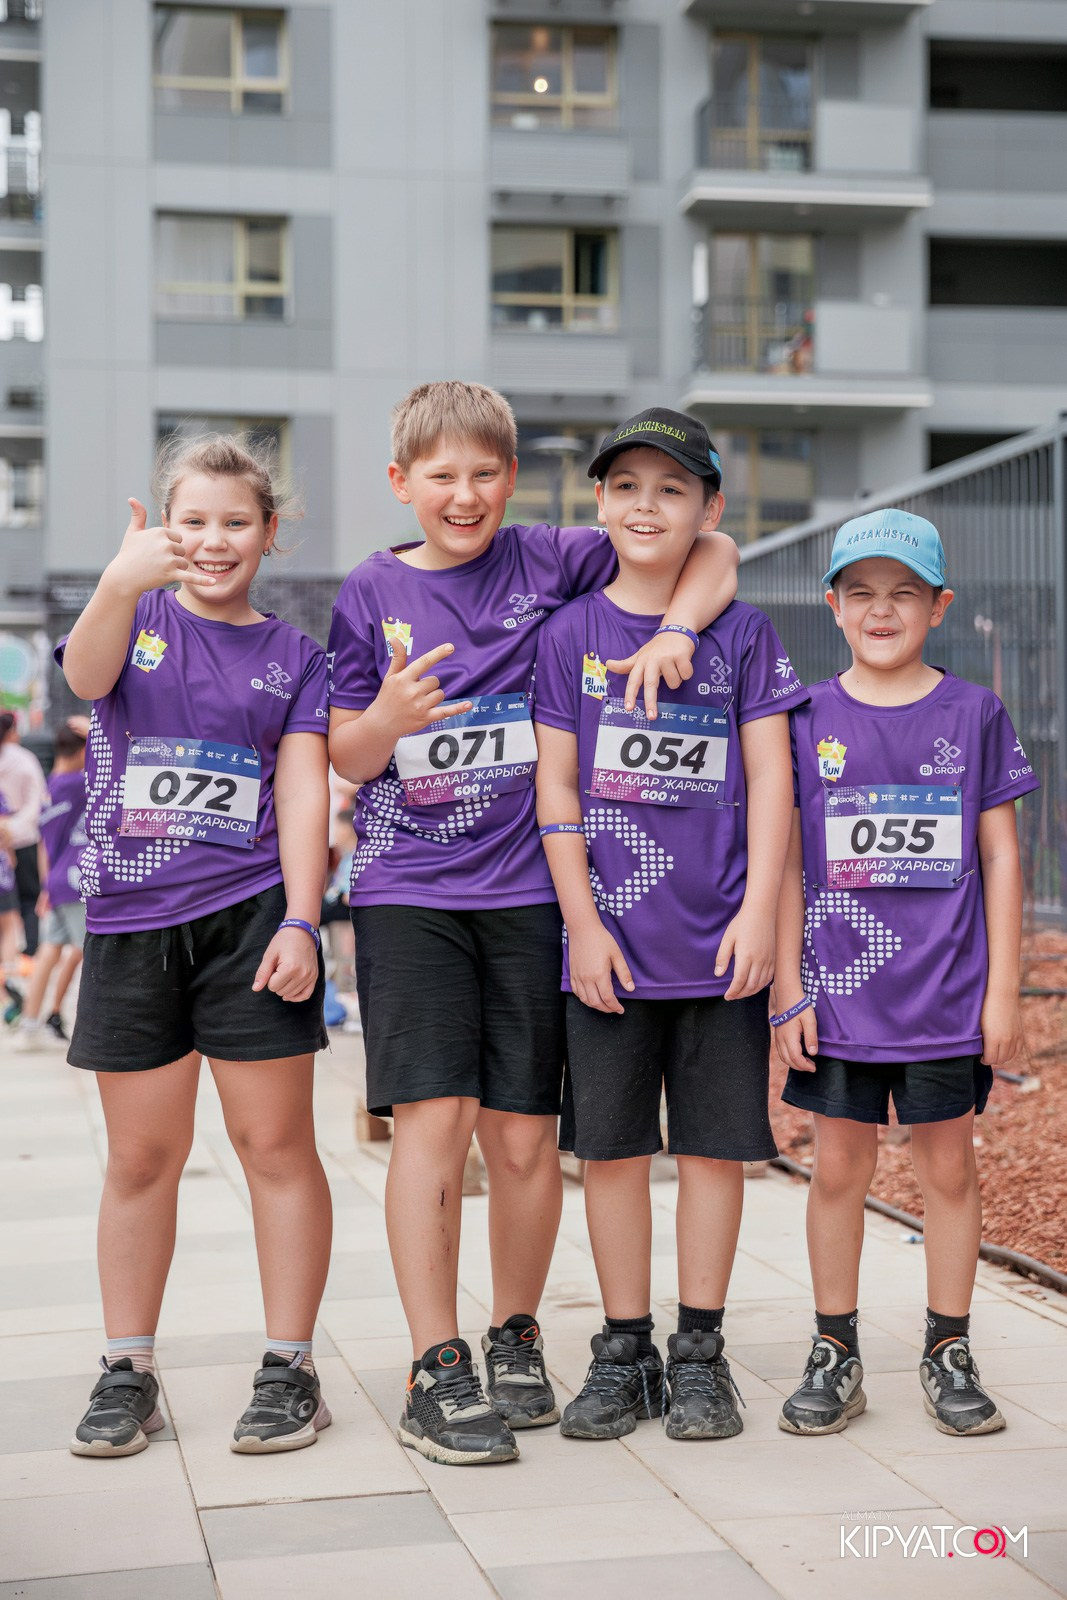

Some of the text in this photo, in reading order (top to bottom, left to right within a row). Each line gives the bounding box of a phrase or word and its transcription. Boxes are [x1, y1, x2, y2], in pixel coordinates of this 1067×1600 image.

[613, 420, 687, 442] KAZAKHSTAN
[846, 528, 919, 548] KAZAKHSTAN
[517, 608, 544, 624] GROUP
[135, 649, 146, 659] BI
[135, 657, 156, 667] RUN
[585, 676, 594, 685] BI
[252, 679, 292, 700] BI GROUP
[587, 685, 605, 693] RUN
[699, 684, 709, 694] BI
[428, 727, 505, 770] 071
[620, 733, 710, 774] 054
[407, 764, 533, 791] БАЛАЛАР ЖАРЫСЫ
[921, 765, 966, 775] BI GROUP
[597, 771, 719, 793] БАЛАЛАР ЖАРЫСЫ
[149, 770, 237, 812] 072
[454, 783, 480, 797] 600
[640, 789, 667, 802] 600
[126, 811, 250, 833] БАЛАЛАР ЖАРЫСЫ
[166, 824, 194, 836] 600
[851, 818, 938, 855] 055
[833, 860, 956, 873] БАЛАЛАР ЖАРЫСЫ
[869, 873, 897, 884] 600
